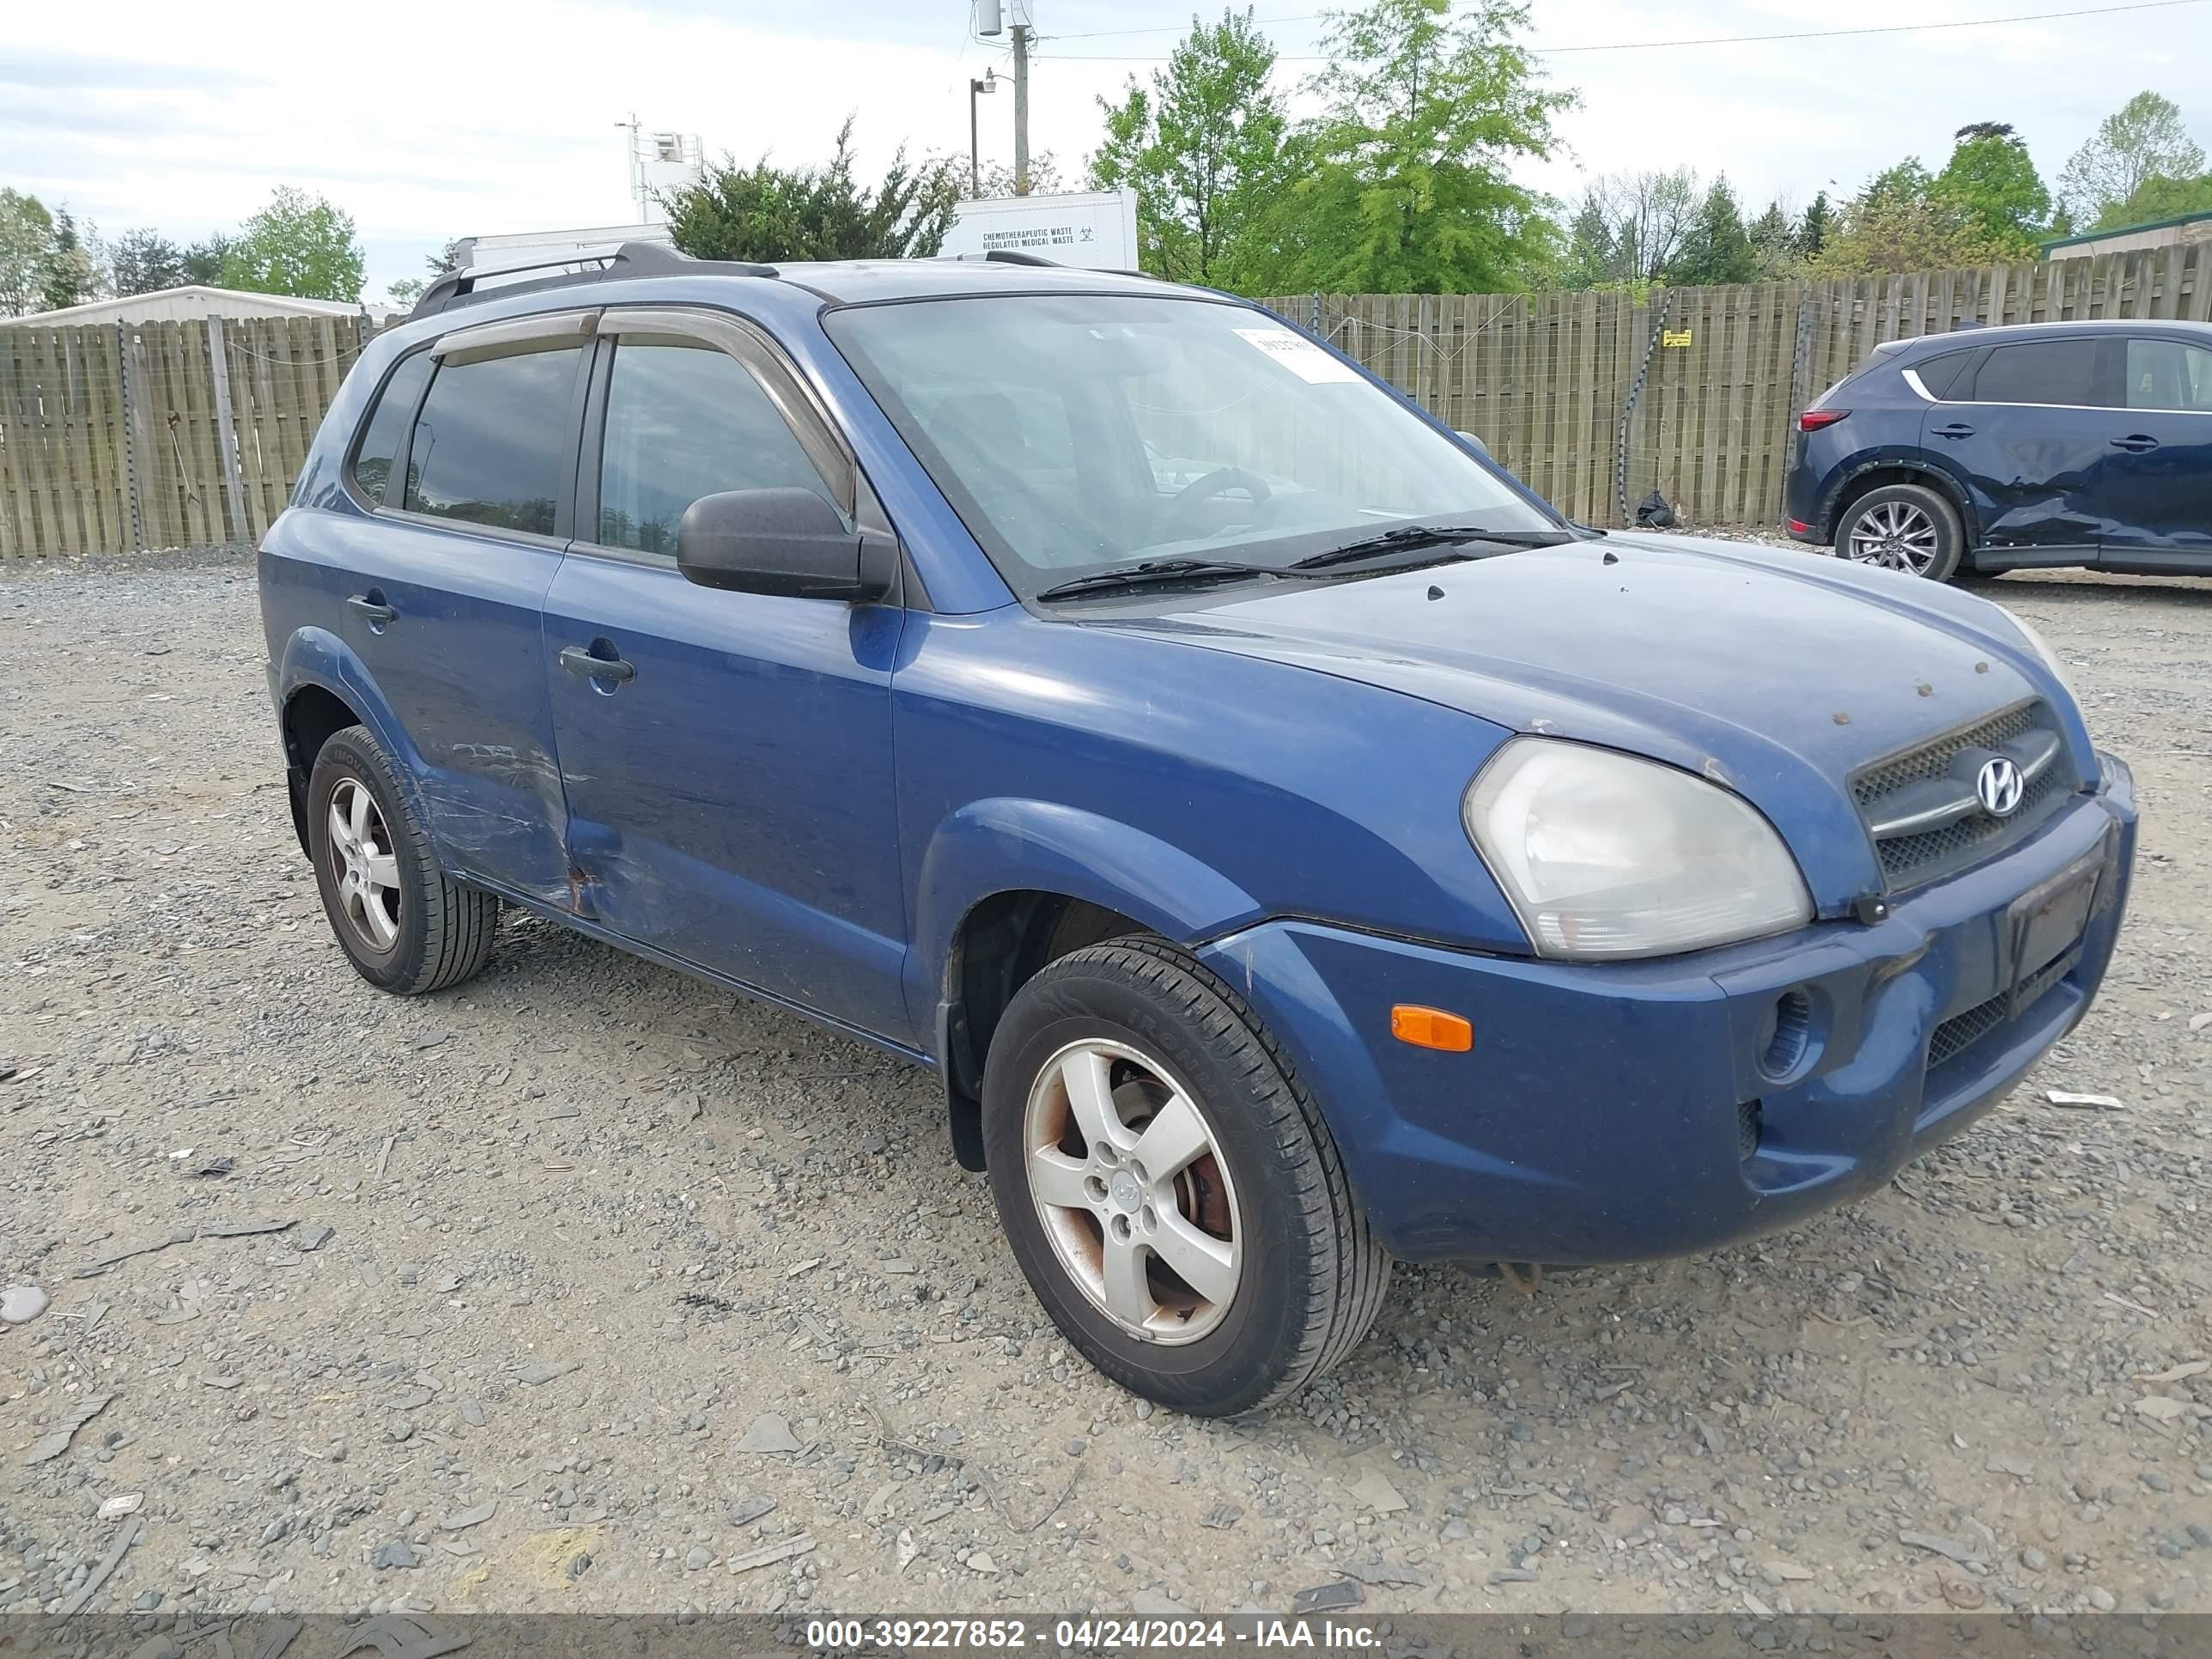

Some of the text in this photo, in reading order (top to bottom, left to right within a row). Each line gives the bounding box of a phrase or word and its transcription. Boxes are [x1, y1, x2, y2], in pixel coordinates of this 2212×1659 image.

[983, 227, 1073, 241] CHEMOTHERAPEUTIC WASTE
[982, 235, 1074, 250] REGULATED MEDICAL WASTE
